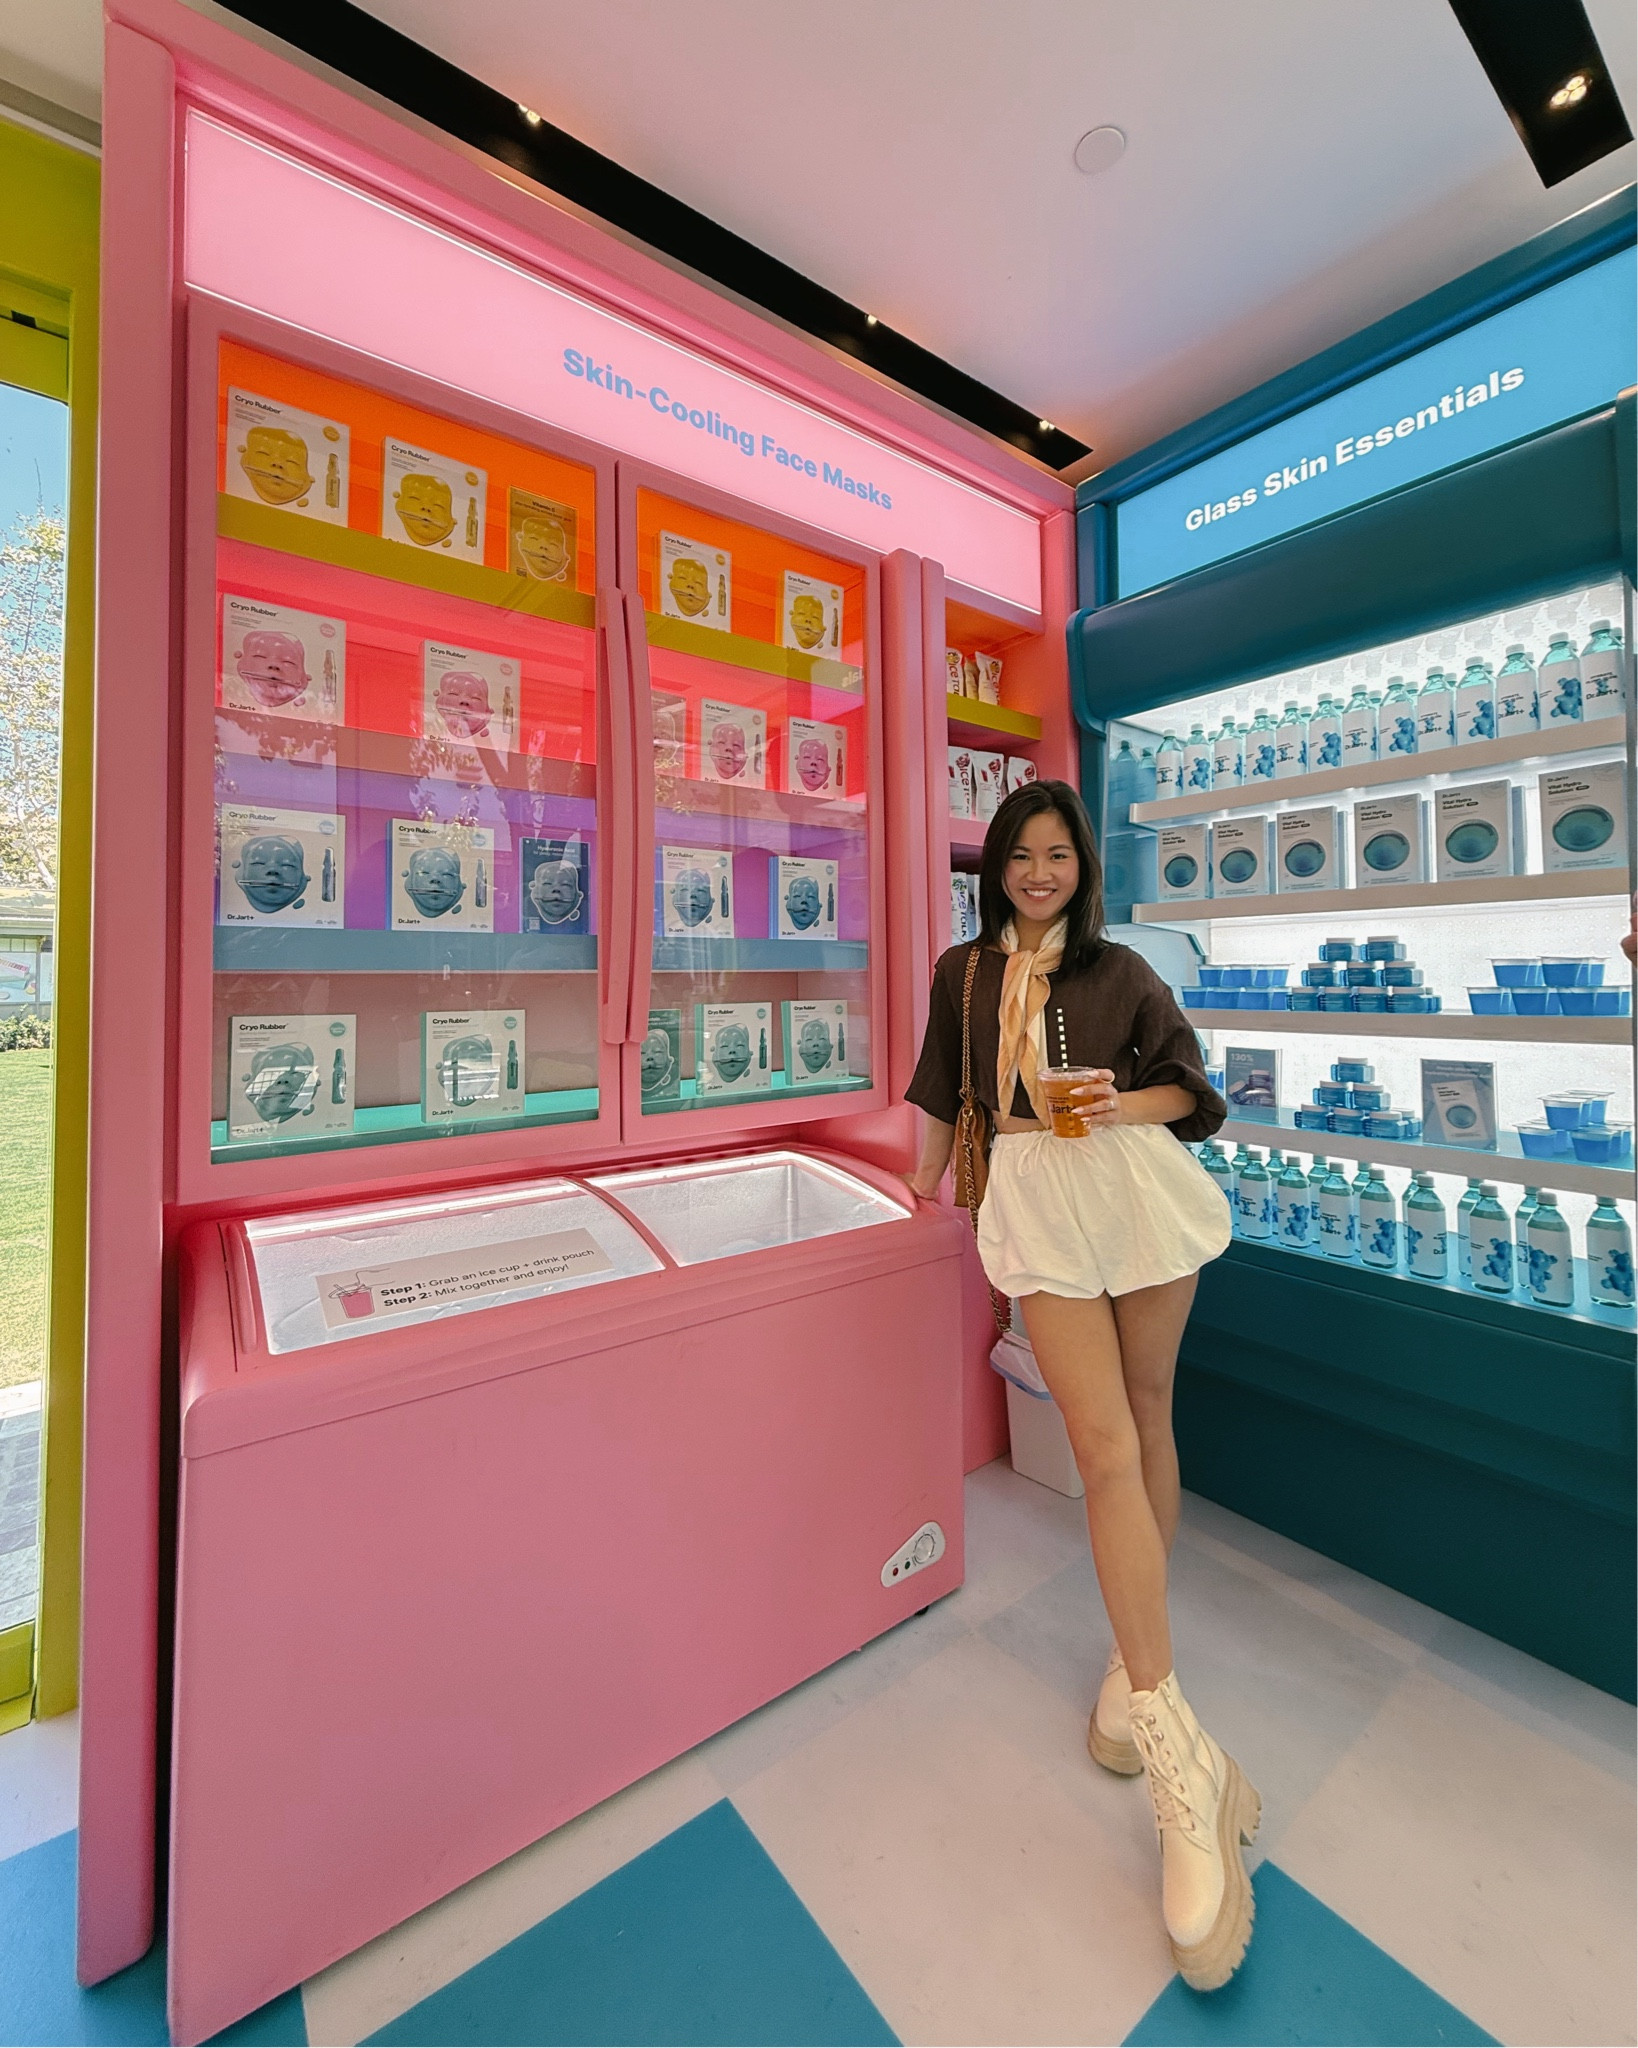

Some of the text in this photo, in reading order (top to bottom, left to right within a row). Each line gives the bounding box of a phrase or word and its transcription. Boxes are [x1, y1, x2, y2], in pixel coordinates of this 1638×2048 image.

[234, 394, 281, 415] Cryo Rubber
[563, 348, 893, 511] Skin-Cooling Face Masks
[391, 444, 430, 462] Cryo Rubber
[1185, 367, 1526, 531] Glass Skin Essentials
[230, 601, 278, 617] Cryo Rubber
[430, 646, 467, 659] Cryo Rubber
[229, 702, 256, 712] Dr.Jart+
[1548, 788, 1574, 796] Solution
[228, 810, 278, 821] Cryo Rubber
[239, 1023, 288, 1032] Cryo Rubber
[380, 1286, 413, 1296] Step
[414, 1282, 426, 1290] 1:
[428, 1276, 460, 1287] Grab
[461, 1273, 477, 1281] an
[478, 1270, 497, 1278] ice
[498, 1264, 521, 1272] cup
[532, 1256, 561, 1267] drink
[561, 1249, 595, 1262] pouch
[383, 1263, 570, 1307] Step 2: Mix together and enjoy!
